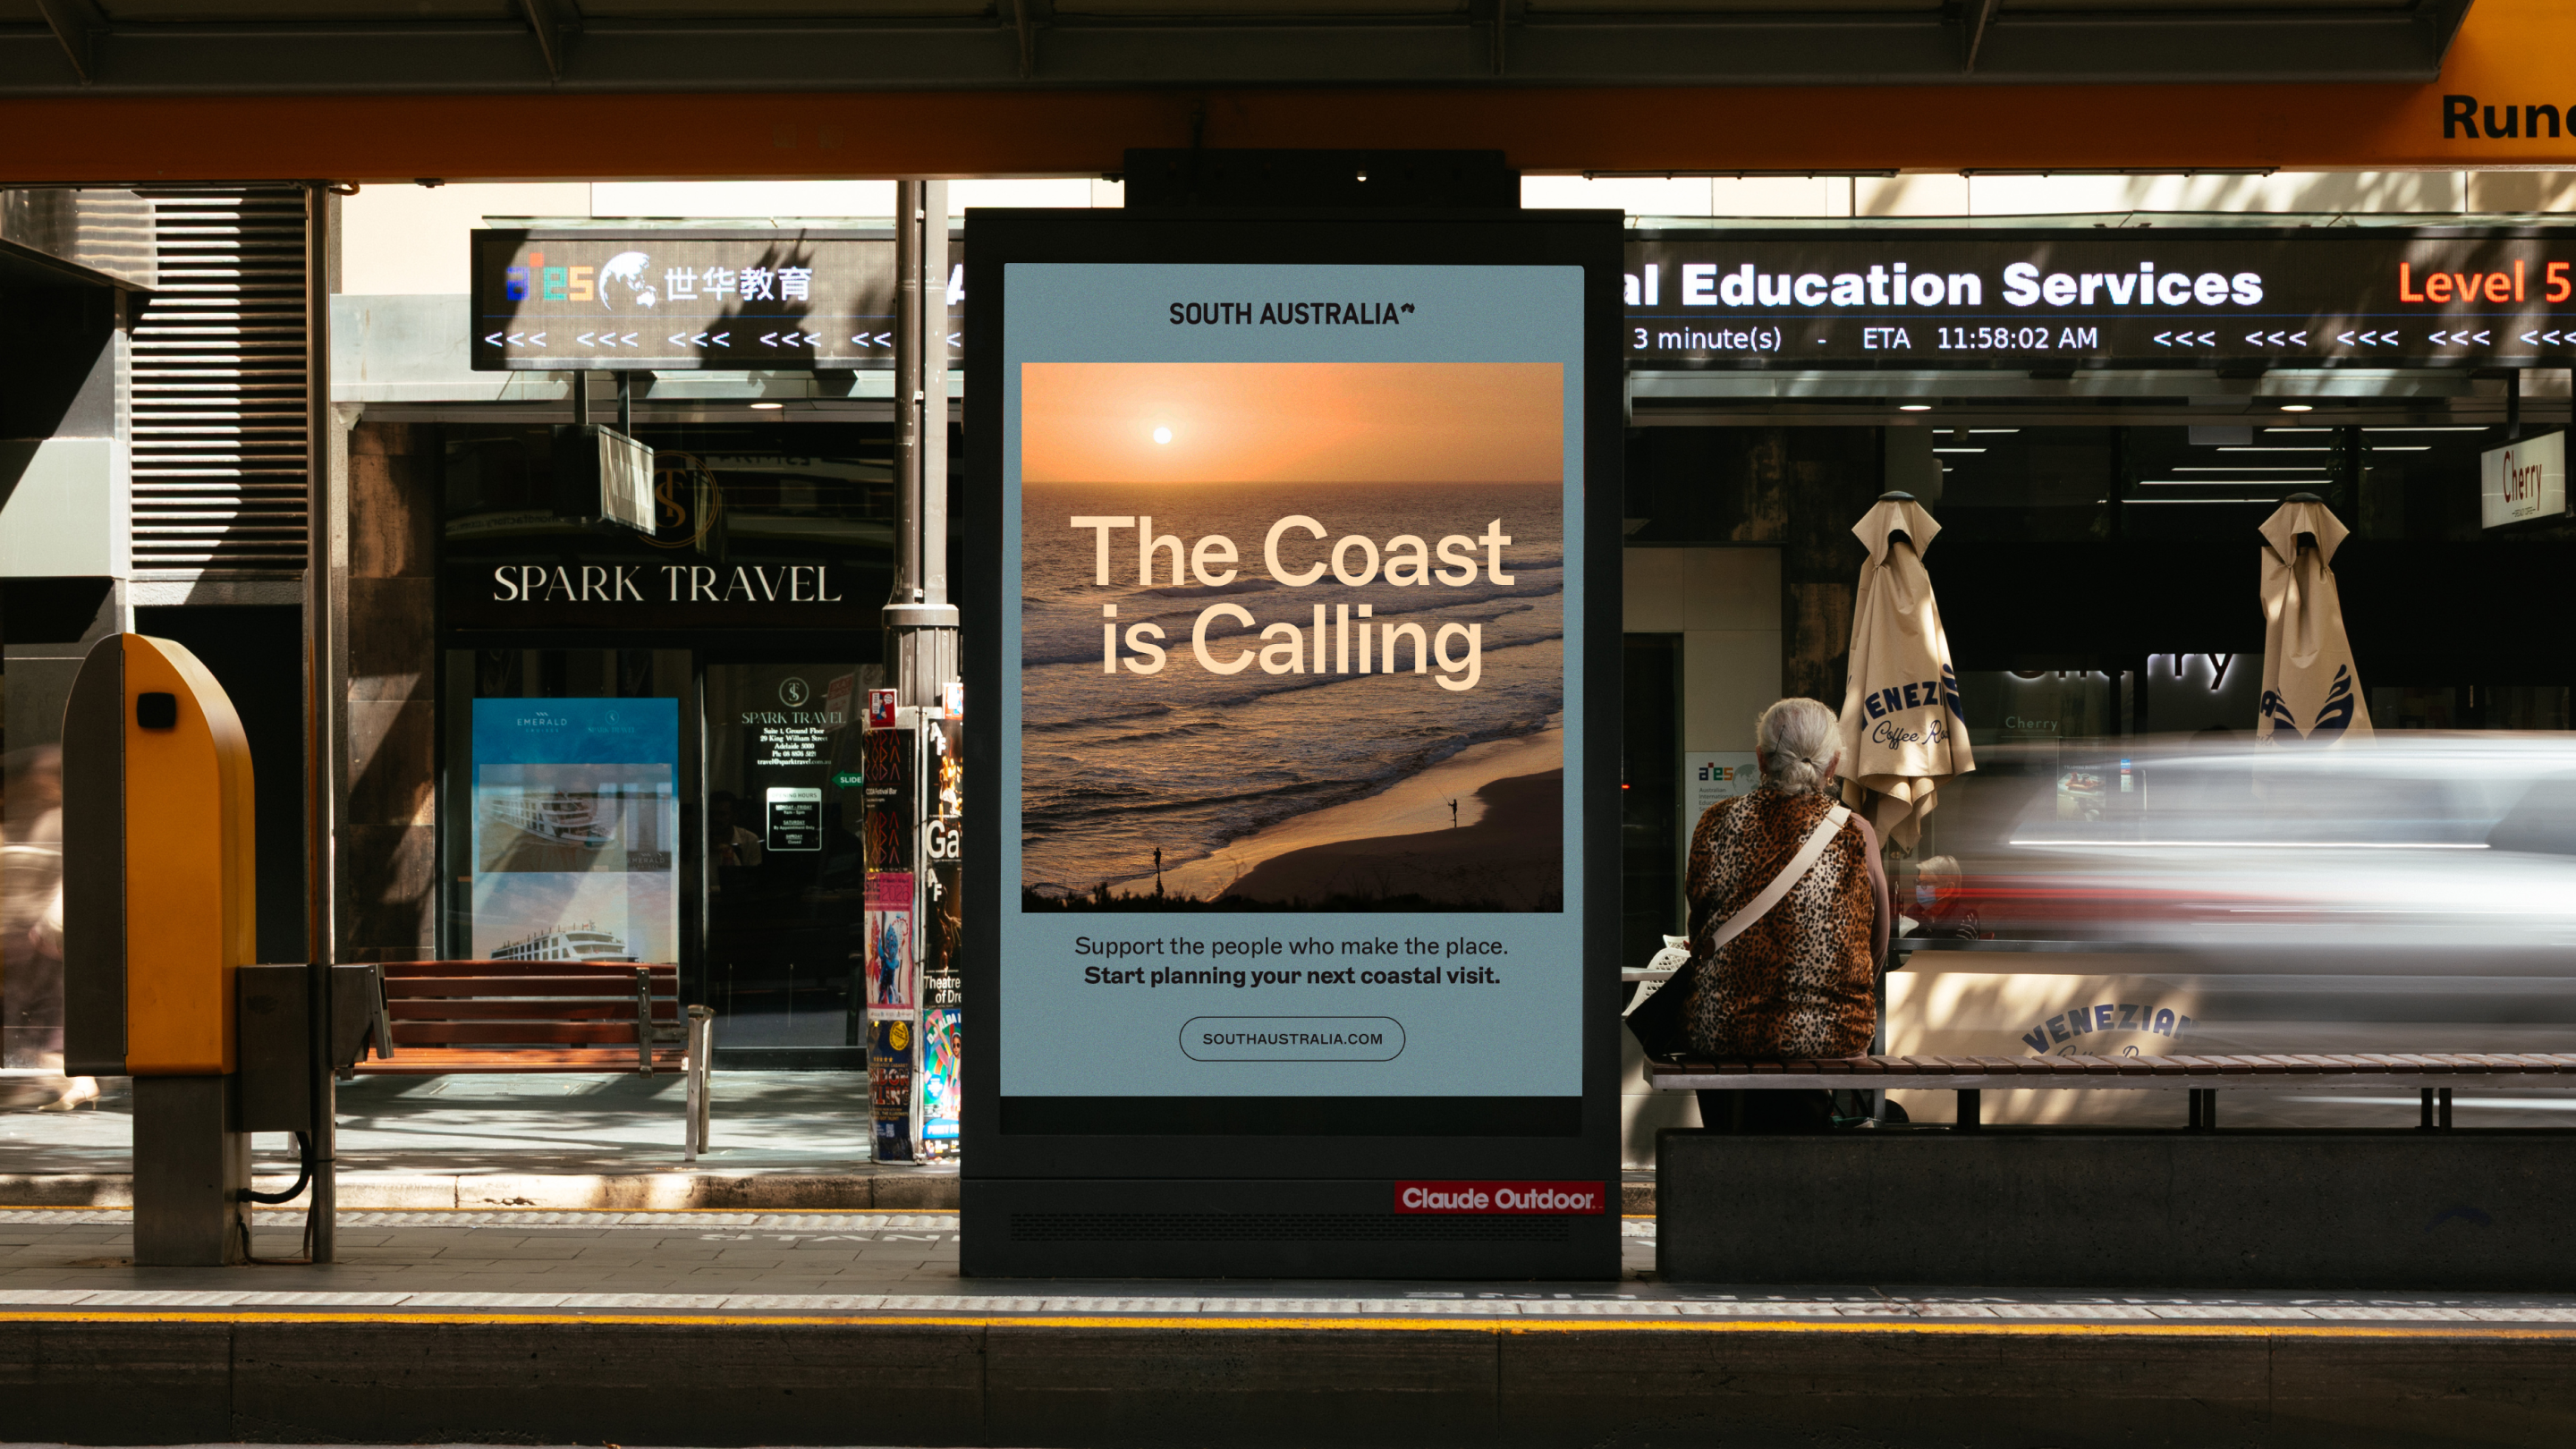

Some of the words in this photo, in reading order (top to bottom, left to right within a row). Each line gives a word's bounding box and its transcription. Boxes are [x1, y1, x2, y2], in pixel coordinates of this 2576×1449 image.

[665, 266, 813, 301] 世华教育
[1682, 262, 1982, 307] Education
[2003, 262, 2264, 307] Services
[2400, 259, 2525, 303] Level
[2546, 261, 2572, 303] 5
[1169, 302, 1252, 325] SOUTH
[1259, 302, 1399, 325] AUSTRALIA
[1633, 327, 1648, 350] 3
[1658, 326, 1782, 352] minute(s)
[1863, 327, 1911, 349] ETA
[1937, 327, 2049, 349] 11:58:02
[2057, 327, 2097, 349] AM
[2504, 450, 2542, 511] Cherry
[1070, 515, 1239, 587] The
[1264, 514, 1515, 587] Coast
[494, 565, 644, 601] SPARK
[661, 566, 842, 601] TRAVEL
[1103, 603, 1166, 675] is
[1191, 602, 1481, 691] Calling
[517, 718, 567, 726] EMERALD
[741, 711, 788, 724] SPARK
[792, 711, 847, 724] TRAVEL
[2005, 716, 2058, 732] Cherry
[1872, 720, 1919, 750] Coffee
[757, 758, 832, 767] travel@sparktravel.com.au
[840, 775, 862, 784] SLIDE
[926, 819, 962, 859] Ga
[881, 885, 910, 902] 2026
[1074, 936, 1165, 959] Support
[1169, 936, 1205, 955] the
[1212, 936, 1283, 959] people
[1288, 936, 1335, 955] who
[1342, 936, 1399, 955] make
[1404, 936, 1440, 955] the
[1446, 936, 1509, 959] place.
[923, 975, 962, 990] Theatre
[1084, 966, 1146, 985] Start
[1150, 966, 1246, 988] planning
[1250, 970, 1302, 988] your
[1307, 966, 1356, 985] next
[1360, 966, 1441, 985] coastal
[1446, 966, 1501, 985] visit.
[935, 989, 947, 1004] of
[927, 1026, 939, 1045] DJ
[939, 1013, 958, 1032] ALBA
[1202, 1032, 1383, 1045] SOUTHAUSTRALIA.COM
[870, 1068, 910, 1086] NDON
[1402, 1187, 1489, 1209] Claude
